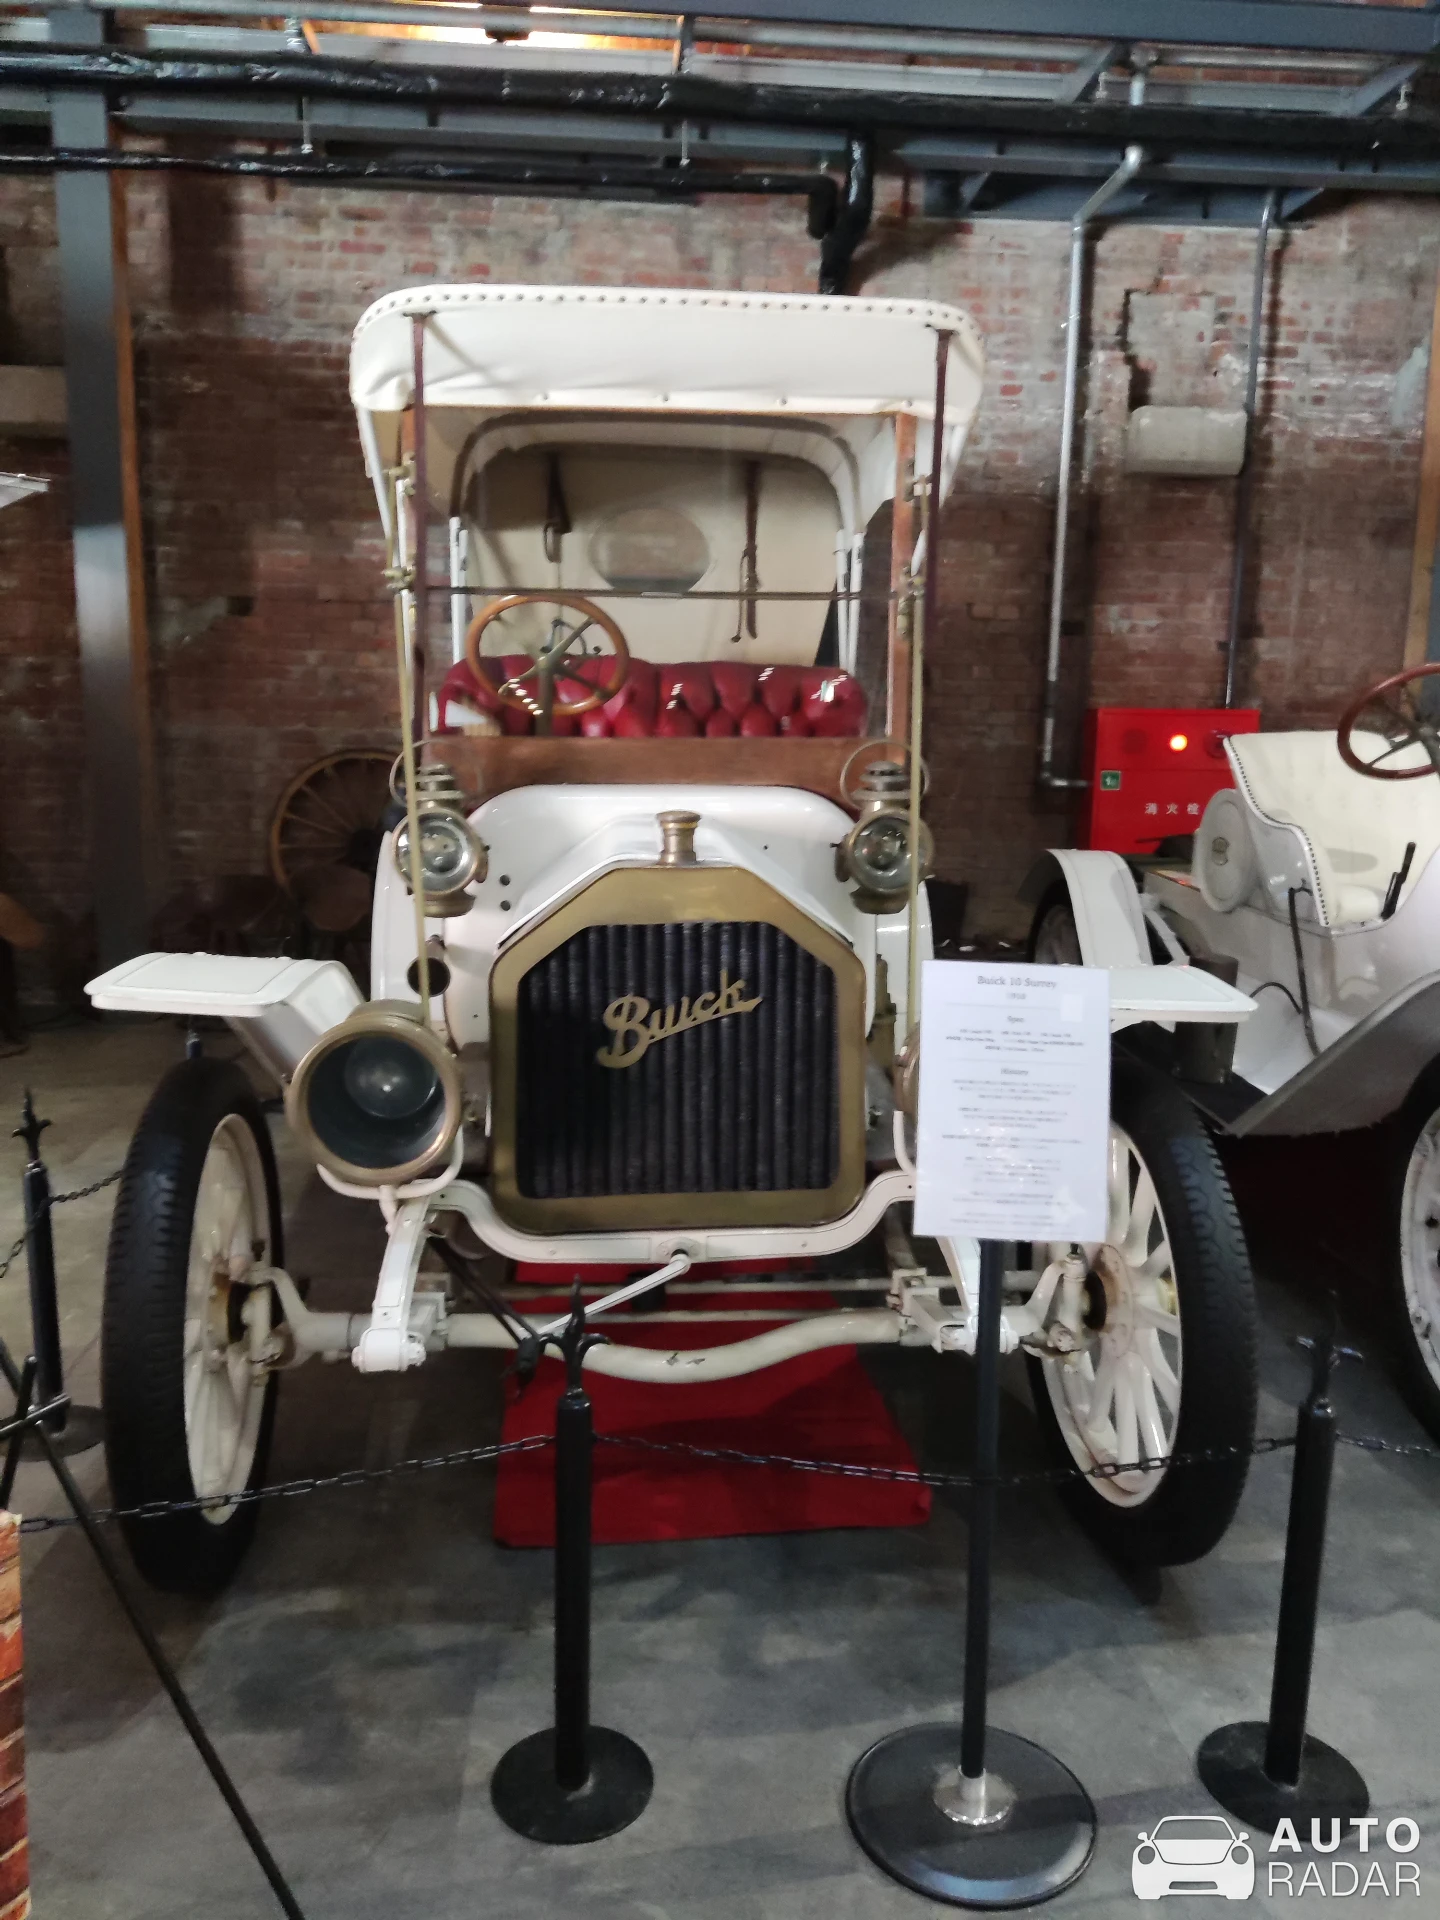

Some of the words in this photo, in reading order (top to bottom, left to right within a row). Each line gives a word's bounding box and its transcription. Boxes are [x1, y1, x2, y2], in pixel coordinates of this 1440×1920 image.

[977, 975, 1006, 986] Buick
[1024, 977, 1057, 990] Surrey
[596, 968, 763, 1069] Buick
